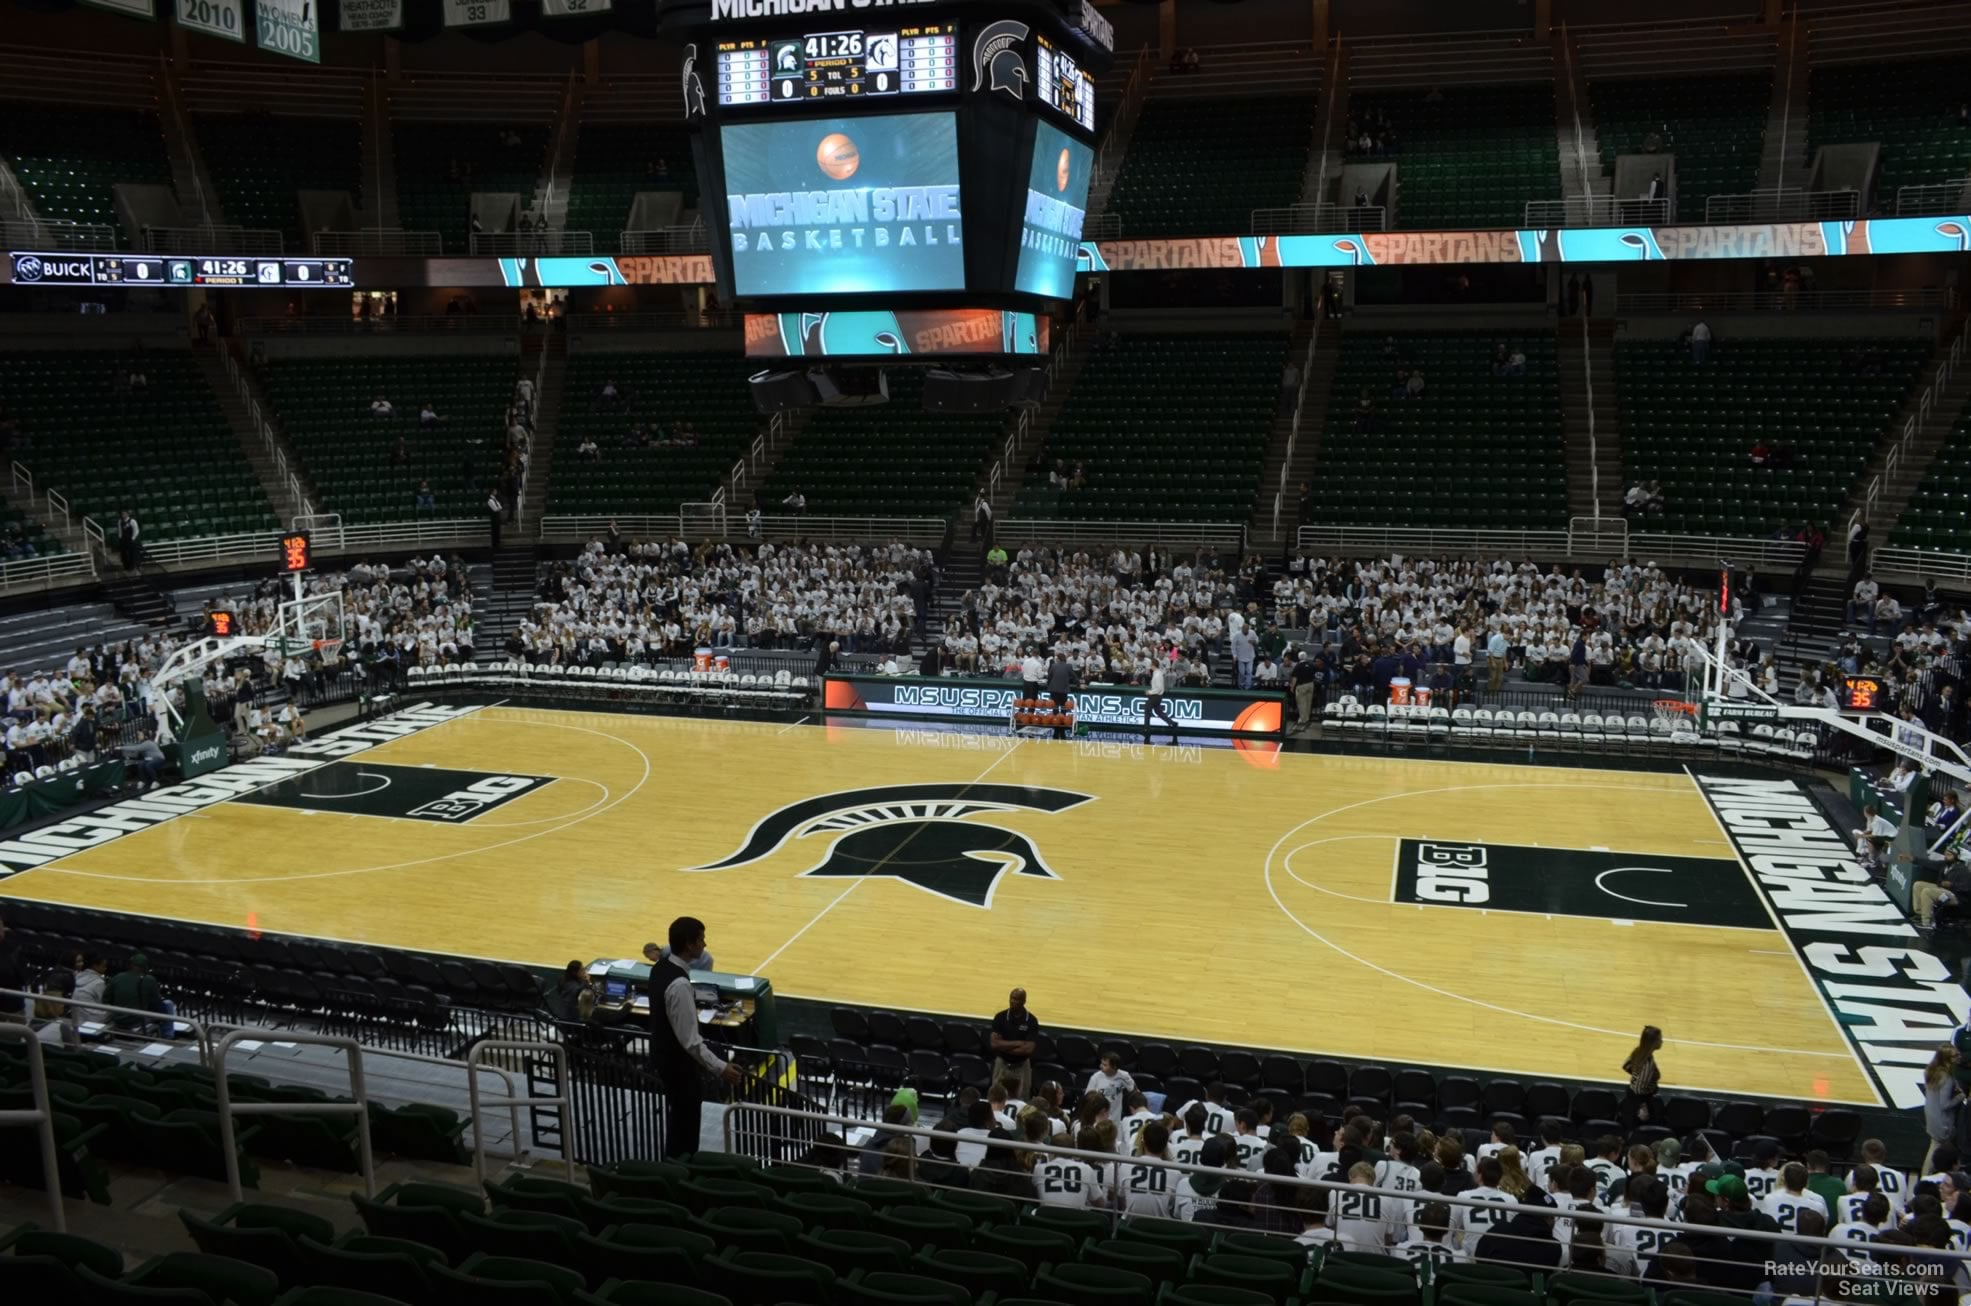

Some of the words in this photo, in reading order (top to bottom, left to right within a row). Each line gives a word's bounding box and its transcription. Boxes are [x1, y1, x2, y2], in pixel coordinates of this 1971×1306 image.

[185, 0, 236, 30] 2010
[468, 6, 486, 21] 33
[262, 20, 314, 57] 2005
[805, 34, 863, 58] 41:26
[815, 59, 846, 67] PERIOD
[811, 70, 818, 81] 5
[851, 67, 859, 78] 5
[877, 73, 888, 92] 0
[782, 80, 793, 98] 0
[811, 86, 818, 97] 0
[825, 86, 845, 96] FOULS
[851, 83, 859, 94] 0
[729, 188, 870, 229] MICHIGAN
[872, 184, 961, 222] STATE
[733, 225, 961, 252] BASKETBALL
[1656, 223, 1825, 260] SPARTANS
[1104, 238, 1242, 270] SPARTANS
[1371, 233, 1521, 265] SPARTANS
[43, 263, 91, 277] BUICK
[136, 263, 148, 279] 0
[202, 260, 247, 275] 41:26
[297, 265, 309, 281] 0
[205, 277, 237, 285] PERIOD
[287, 549, 305, 569] 35
[216, 622, 228, 634] 35
[1852, 691, 1871, 707] 35
[1096, 714, 1140, 726] ATHLETICS
[1723, 708, 1744, 717] FARM
[1744, 709, 1777, 718] BUREAU
[289, 701, 485, 757] STATE
[190, 746, 220, 765] xfinity
[1875, 736, 1942, 768] msuspartans.com
[1698, 774, 1920, 938] MICHIGAN
[1044, 1165, 1082, 1194] 20
[1130, 1165, 1167, 1195] 20
[1341, 1191, 1381, 1222] 20
[1469, 1196, 1507, 1224] 20
